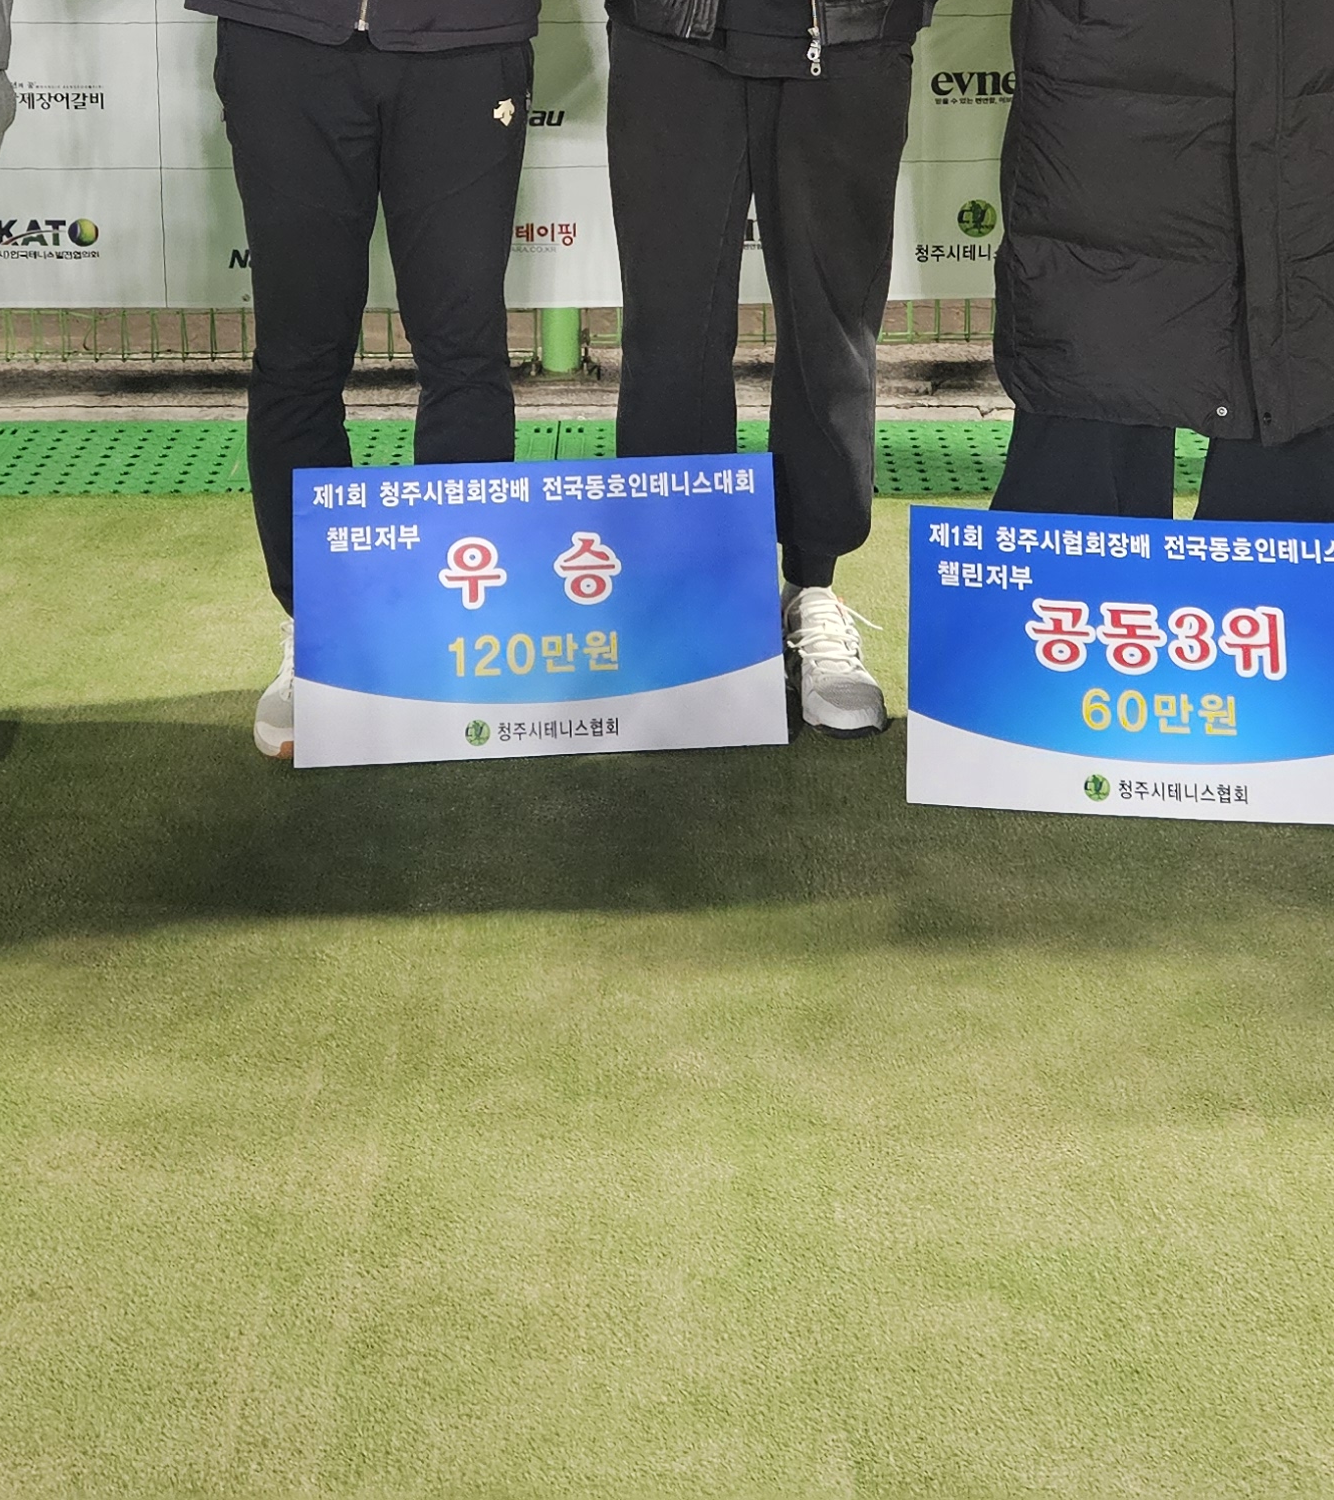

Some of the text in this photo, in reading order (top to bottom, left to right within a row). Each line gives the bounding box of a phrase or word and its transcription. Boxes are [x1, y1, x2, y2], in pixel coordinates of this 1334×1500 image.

[17, 92, 105, 110] 제장어갈비
[515, 222, 577, 247] 테이핑
[915, 243, 998, 263] 청주시테니
[312, 469, 755, 509] 제1회 청주시협회장배 전국동호인테니스대회
[326, 524, 421, 553] 챌린저부
[929, 523, 983, 550] 제1회
[996, 527, 1151, 560] 청주시협회장배
[439, 531, 621, 609] 우 승
[938, 561, 1033, 591] 챌린저부
[448, 630, 620, 678] 120만원
[1025, 598, 1287, 680] 공동3위
[1082, 687, 1237, 737] 60만원
[497, 717, 620, 742] 청주시테니스협회
[1118, 779, 1249, 805] 청주시테니스협회
